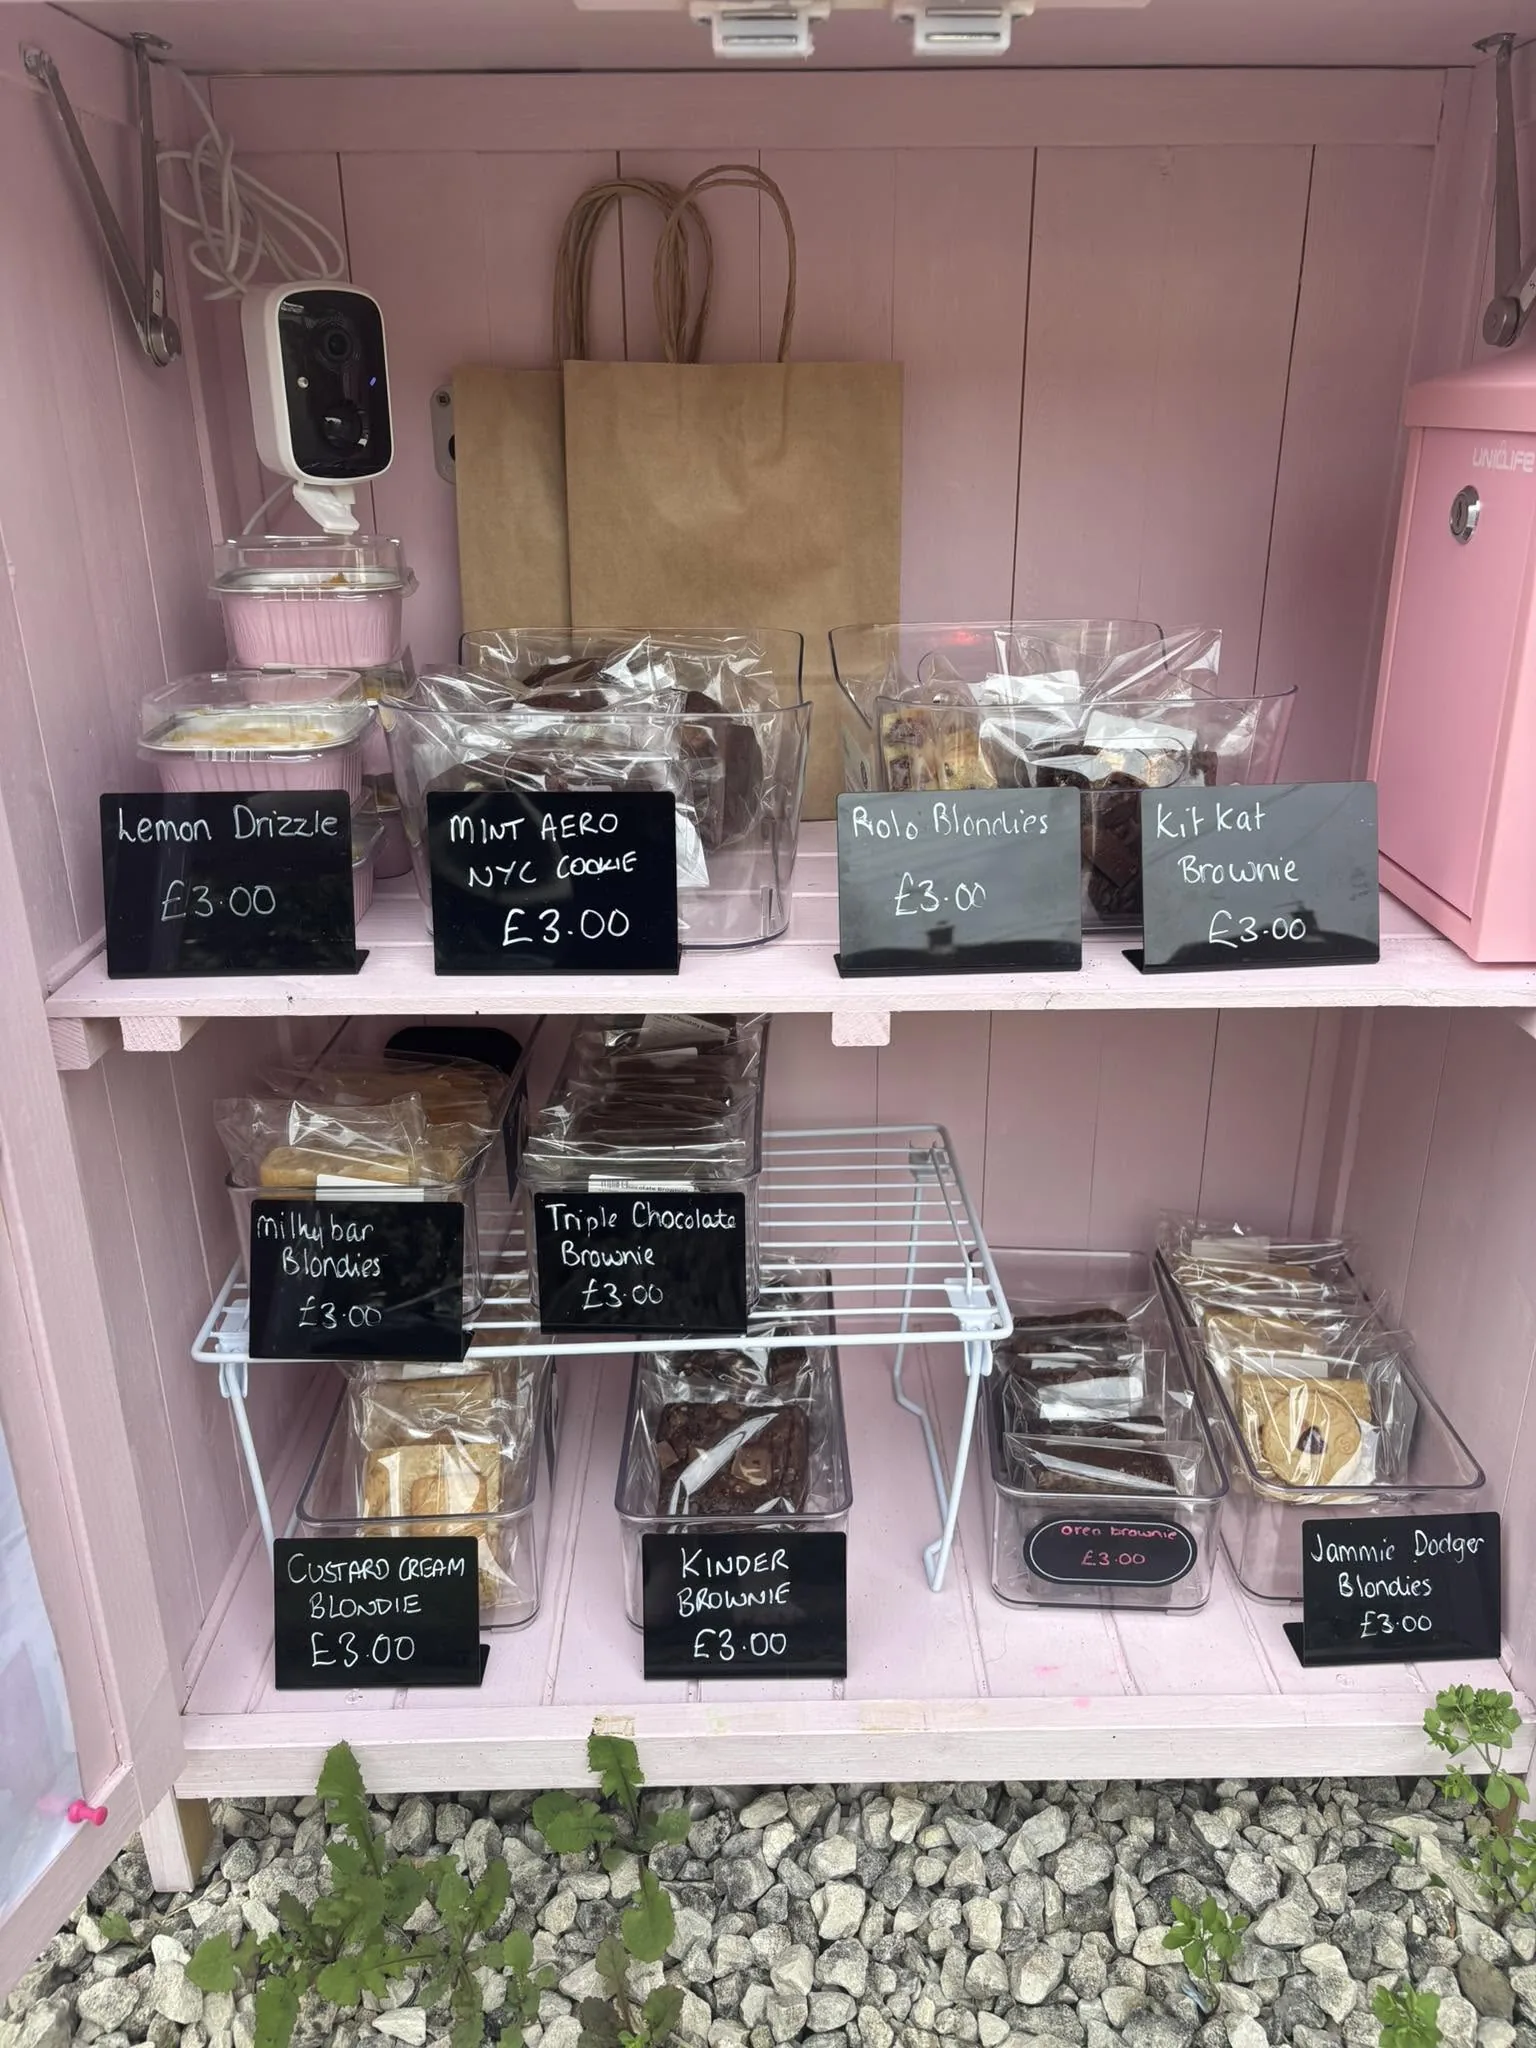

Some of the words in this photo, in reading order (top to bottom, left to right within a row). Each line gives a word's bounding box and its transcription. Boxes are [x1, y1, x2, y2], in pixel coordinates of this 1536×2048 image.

[118, 807, 213, 843] Lemon
[233, 804, 338, 840] Drizzle
[450, 814, 525, 845] MINT
[540, 811, 618, 843] AERO
[852, 805, 919, 841] Rolo
[932, 801, 1049, 837] Blondies
[1156, 802, 1205, 839] Kit
[1216, 801, 1266, 832] Kat
[468, 860, 537, 888] NYC
[556, 850, 638, 880] COOKIE
[1177, 854, 1299, 884] Brownie
[160, 879, 276, 922] £3.00
[894, 871, 986, 916] £3.00
[502, 907, 630, 947] £3.00
[1208, 909, 1306, 949] £3.00
[545, 1202, 618, 1236] Triple
[632, 1200, 737, 1230] Chocolate
[282, 1246, 381, 1279] Blondies
[561, 1239, 655, 1268] Brownie
[581, 1278, 664, 1311] £3.00
[298, 1295, 382, 1330] £3.00
[680, 1547, 790, 1579] KINDER
[1080, 1549, 1146, 1567] £3.00
[1310, 1533, 1396, 1563] Jammie
[1414, 1529, 1485, 1564] Dodger
[287, 1552, 390, 1584] CUSTARD
[398, 1556, 466, 1582] CREAM
[1338, 1571, 1432, 1599] Blondies
[309, 1591, 422, 1620] BLONDIE
[676, 1581, 791, 1618] BROWNIE
[1360, 1610, 1433, 1639] £3.00
[310, 1631, 415, 1668] £3.00
[693, 1628, 787, 1661] £3.00
